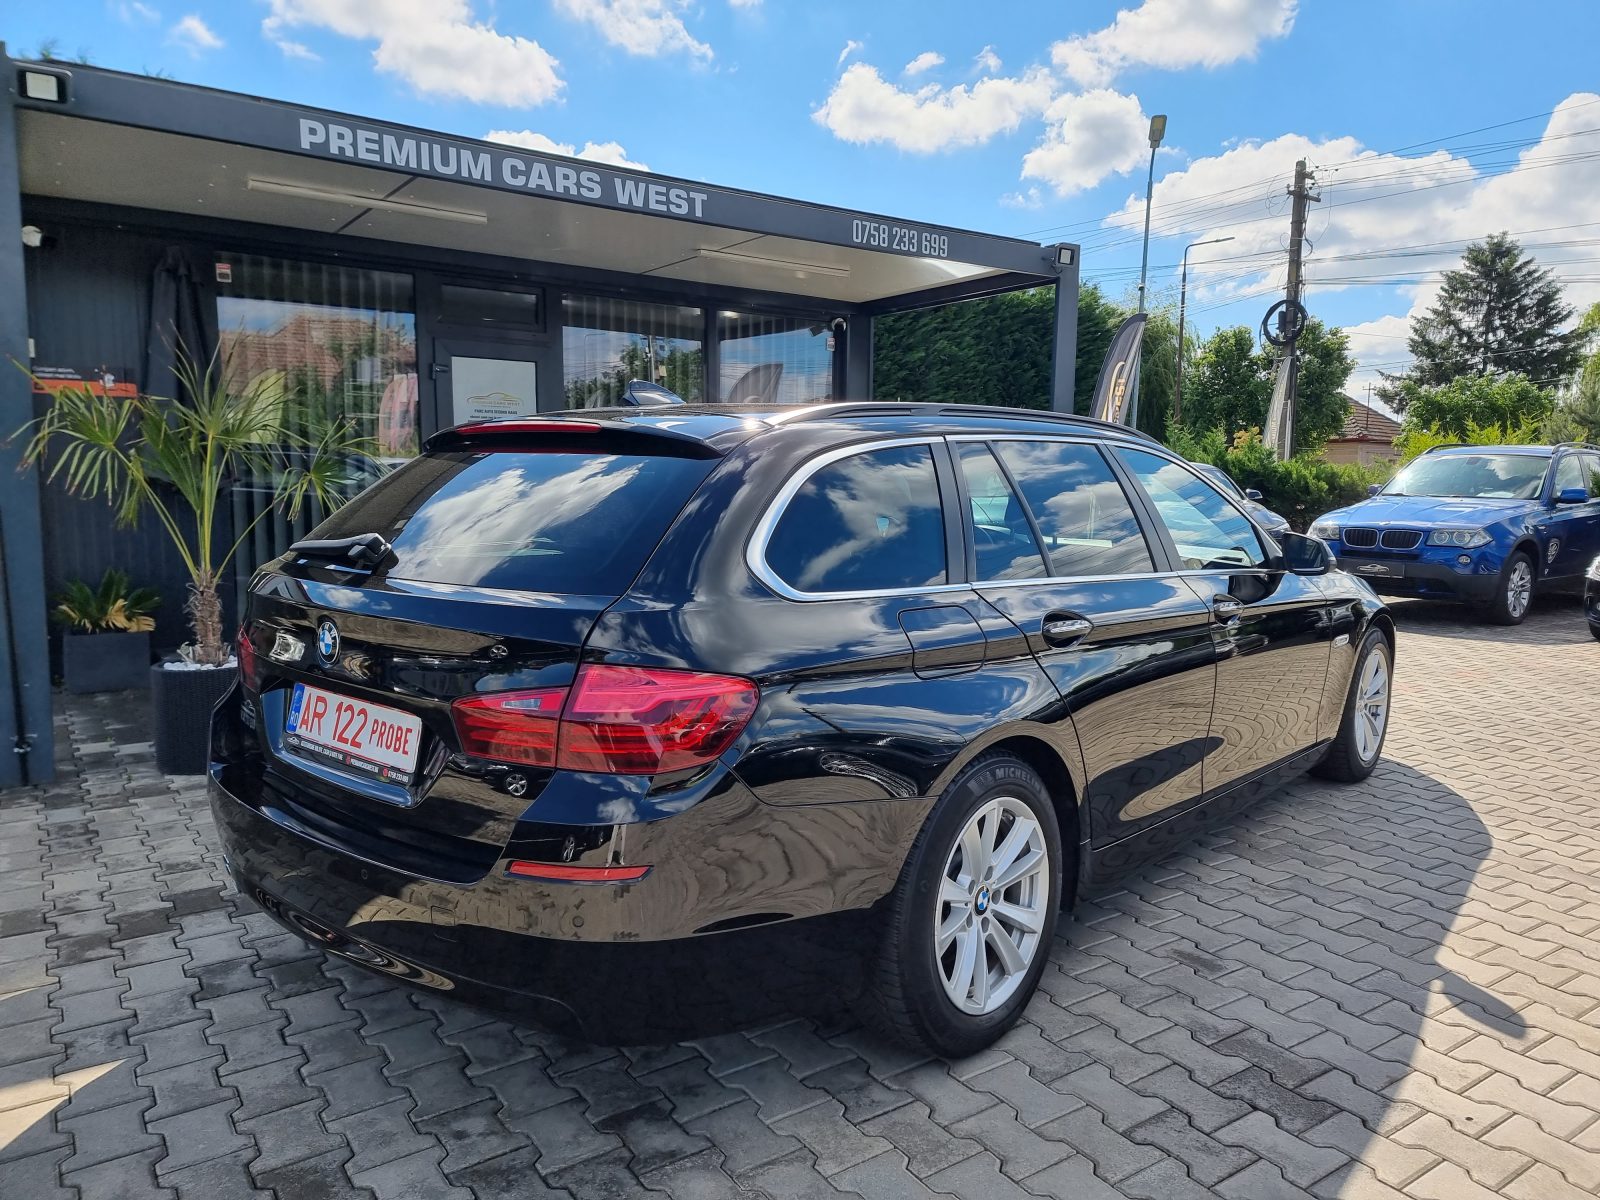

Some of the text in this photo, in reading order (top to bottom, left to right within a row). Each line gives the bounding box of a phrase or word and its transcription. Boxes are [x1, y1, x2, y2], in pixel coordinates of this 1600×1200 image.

[299, 117, 708, 218] PREMIUM CARS WEST
[852, 219, 948, 258] 0758 233 699
[290, 711, 300, 727] RO
[299, 692, 328, 737] AR
[332, 701, 368, 749] 122
[368, 718, 413, 756] PROBE
[995, 767, 1041, 791] MICHELIN
